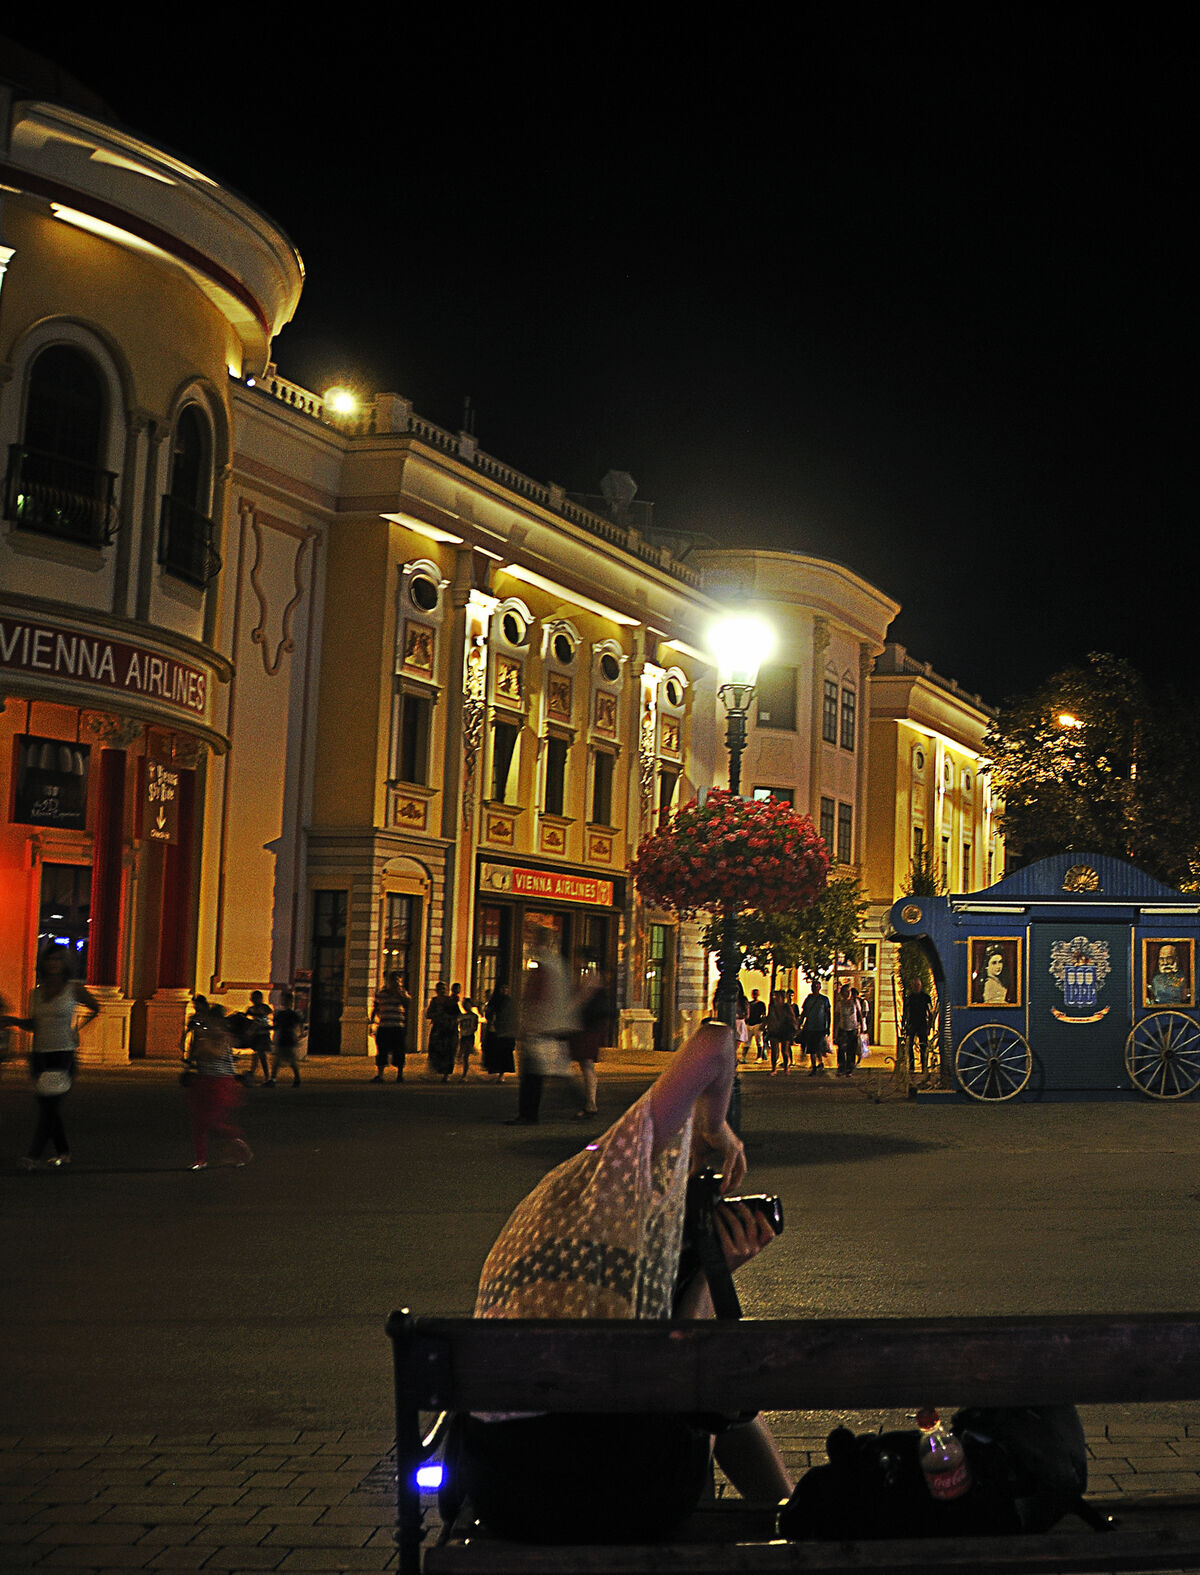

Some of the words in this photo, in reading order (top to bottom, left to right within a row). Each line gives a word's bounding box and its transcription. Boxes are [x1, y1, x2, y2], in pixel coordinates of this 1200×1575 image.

[0, 623, 116, 684] VIENNA
[125, 652, 205, 710] AIRLINES
[515, 874, 552, 892] VIENNA
[556, 880, 595, 898] AIRLINES
